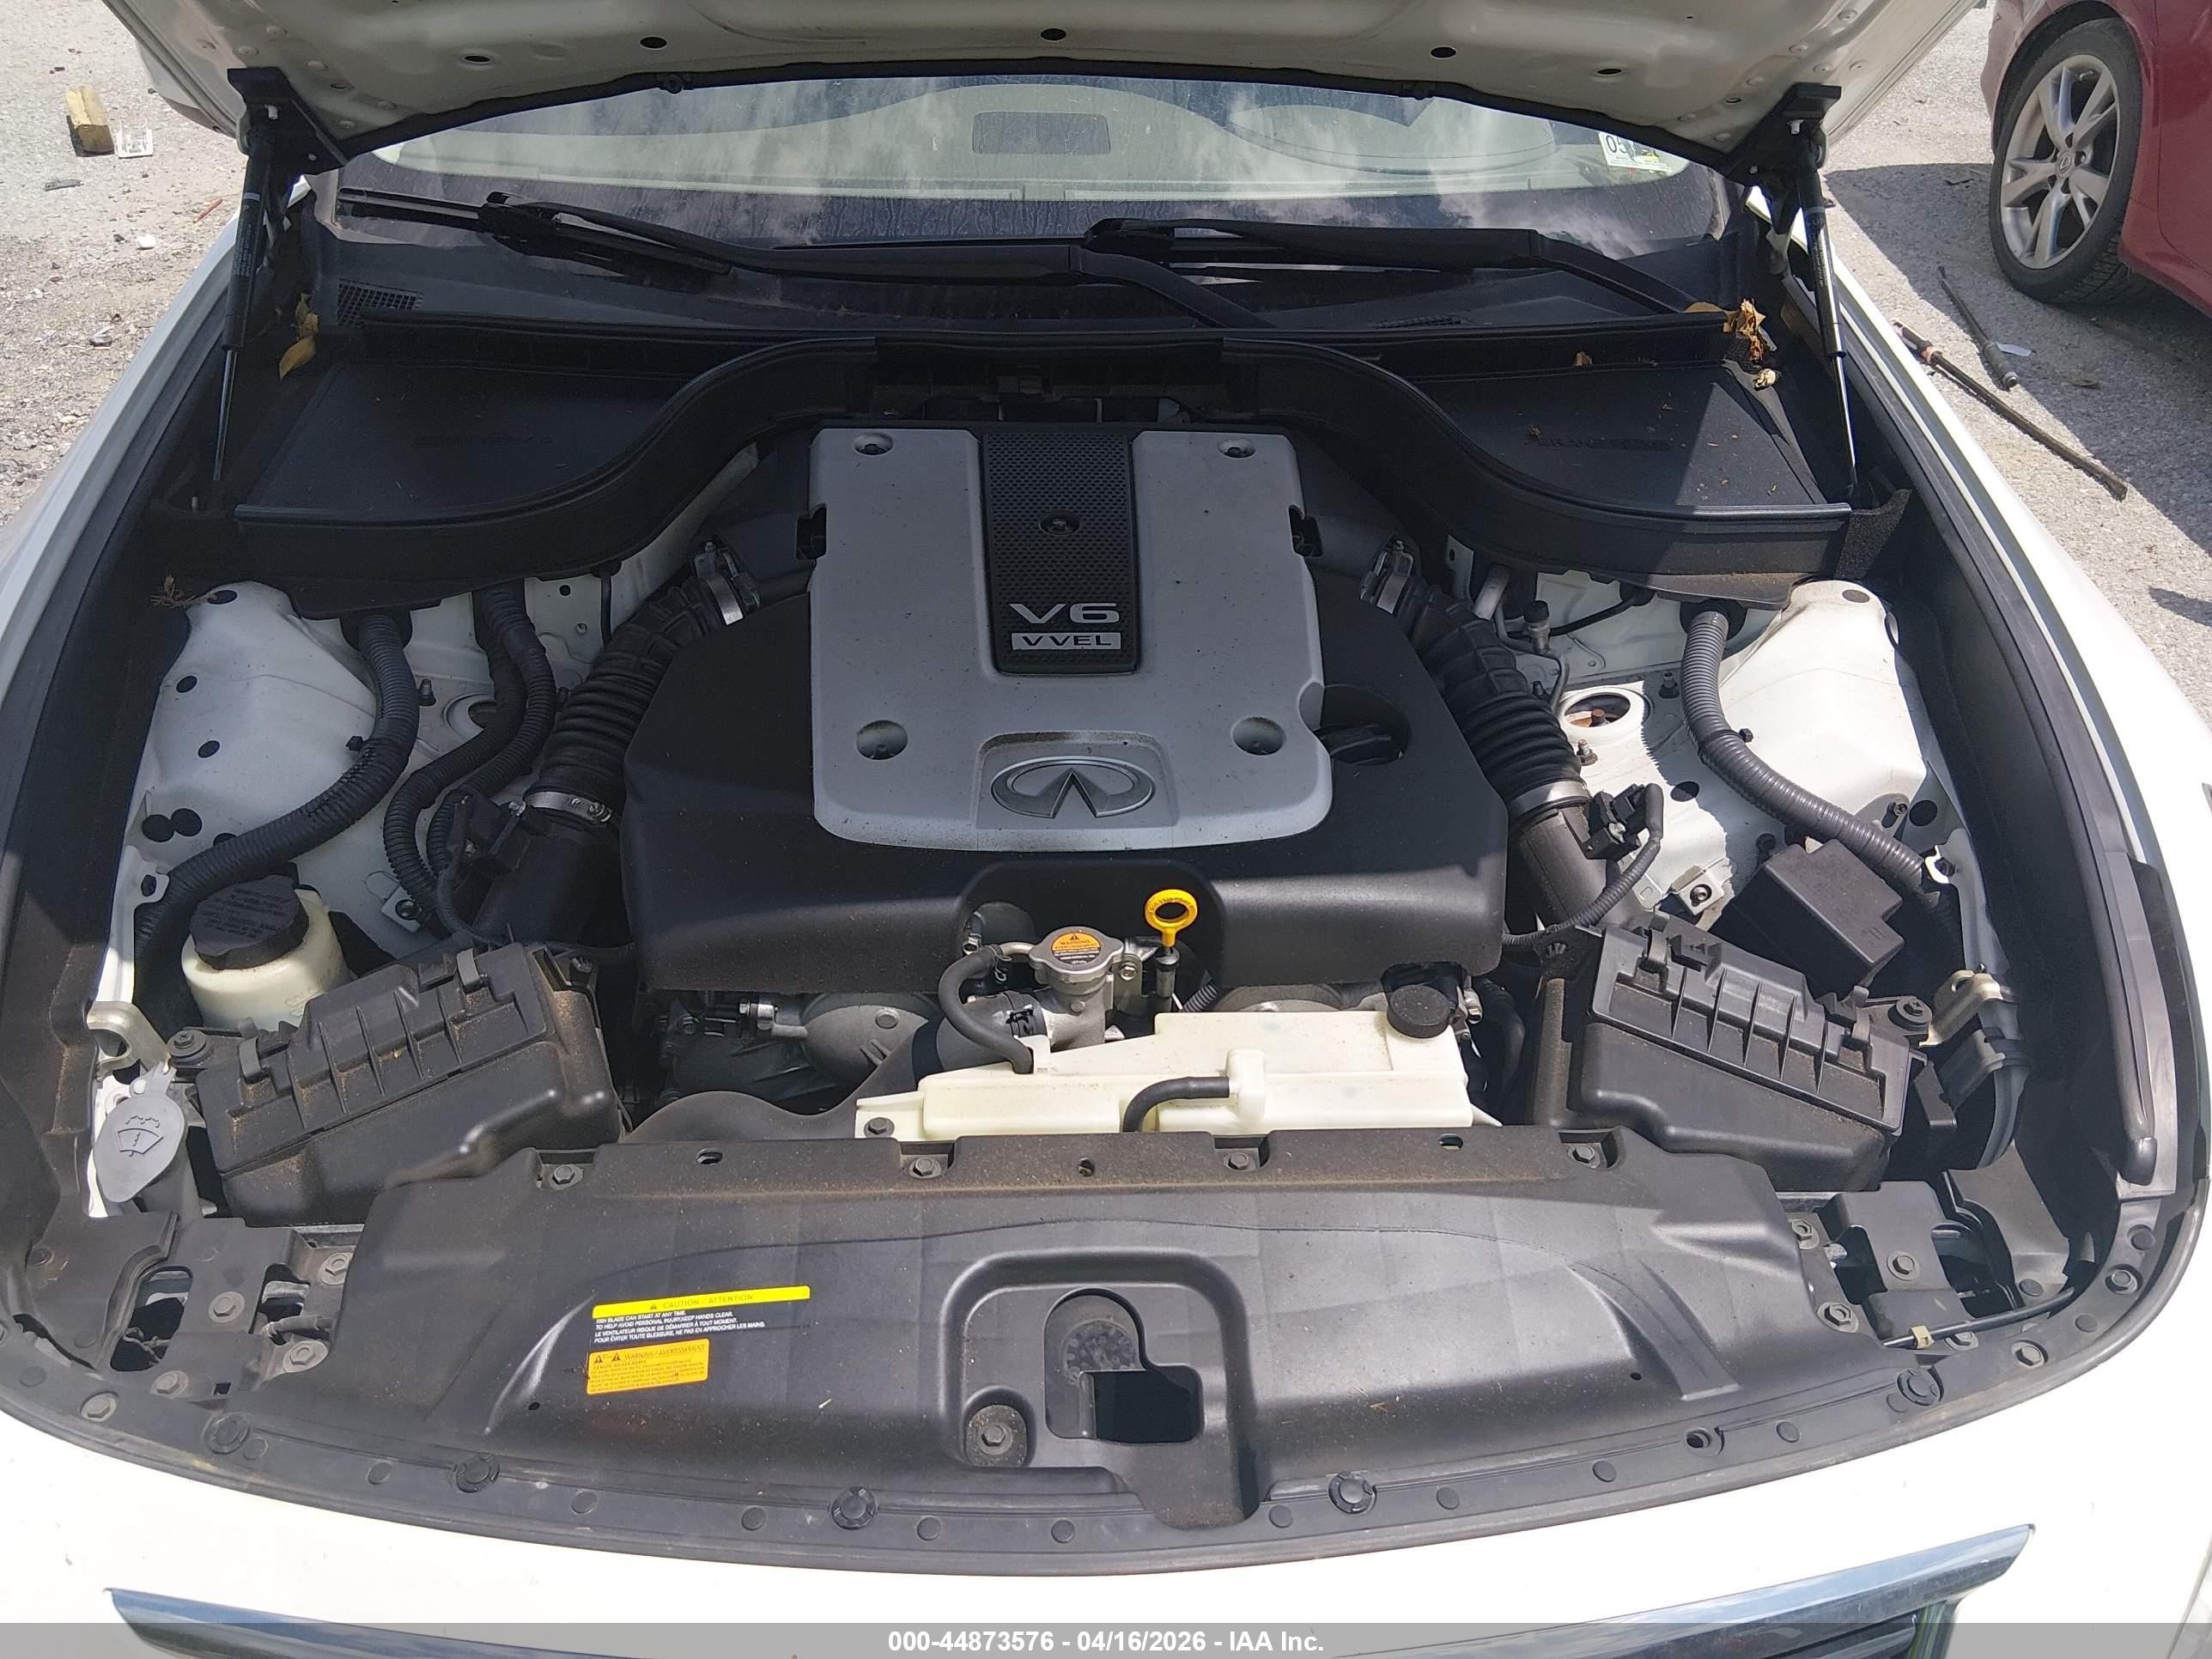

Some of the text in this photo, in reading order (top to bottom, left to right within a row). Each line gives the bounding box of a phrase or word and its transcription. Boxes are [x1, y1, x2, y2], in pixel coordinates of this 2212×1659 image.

[1009, 603, 1120, 624] V6
[1022, 635, 1112, 647] VVEL
[663, 1299, 700, 1309] CAUTION
[708, 1293, 754, 1304] ATTENTION
[635, 1318, 663, 1327] PERSONAL
[702, 1322, 737, 1332] APPROCHER
[602, 1328, 636, 1337] VENTILATEUR
